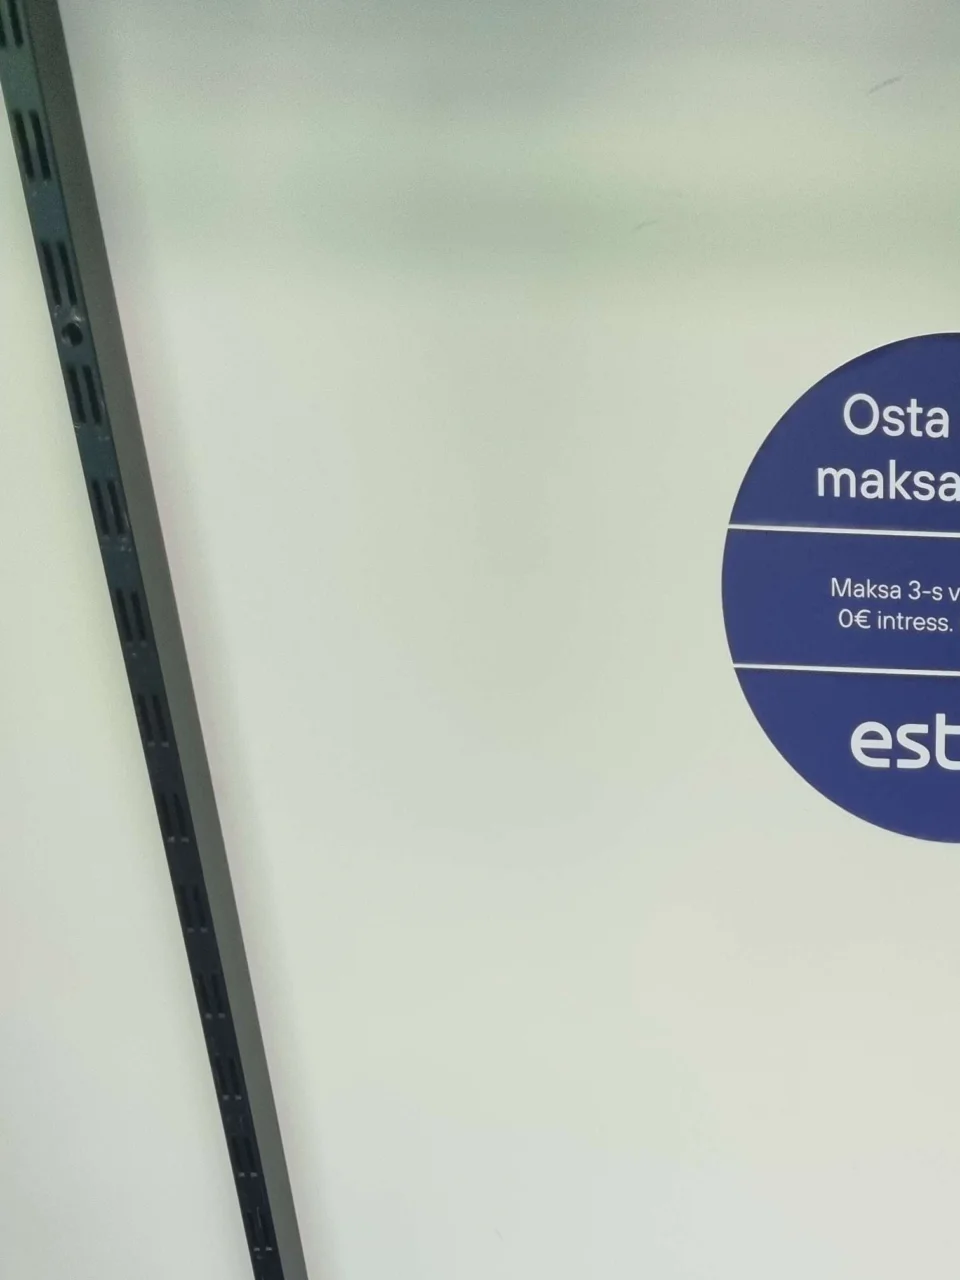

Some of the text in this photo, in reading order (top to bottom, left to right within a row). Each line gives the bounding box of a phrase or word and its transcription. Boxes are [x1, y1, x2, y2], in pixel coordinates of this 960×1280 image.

[843, 393, 949, 438] Osta
[831, 577, 901, 600] Maksa
[908, 580, 943, 601] 3-s
[838, 608, 871, 629] 0€
[877, 611, 953, 632] intress.
